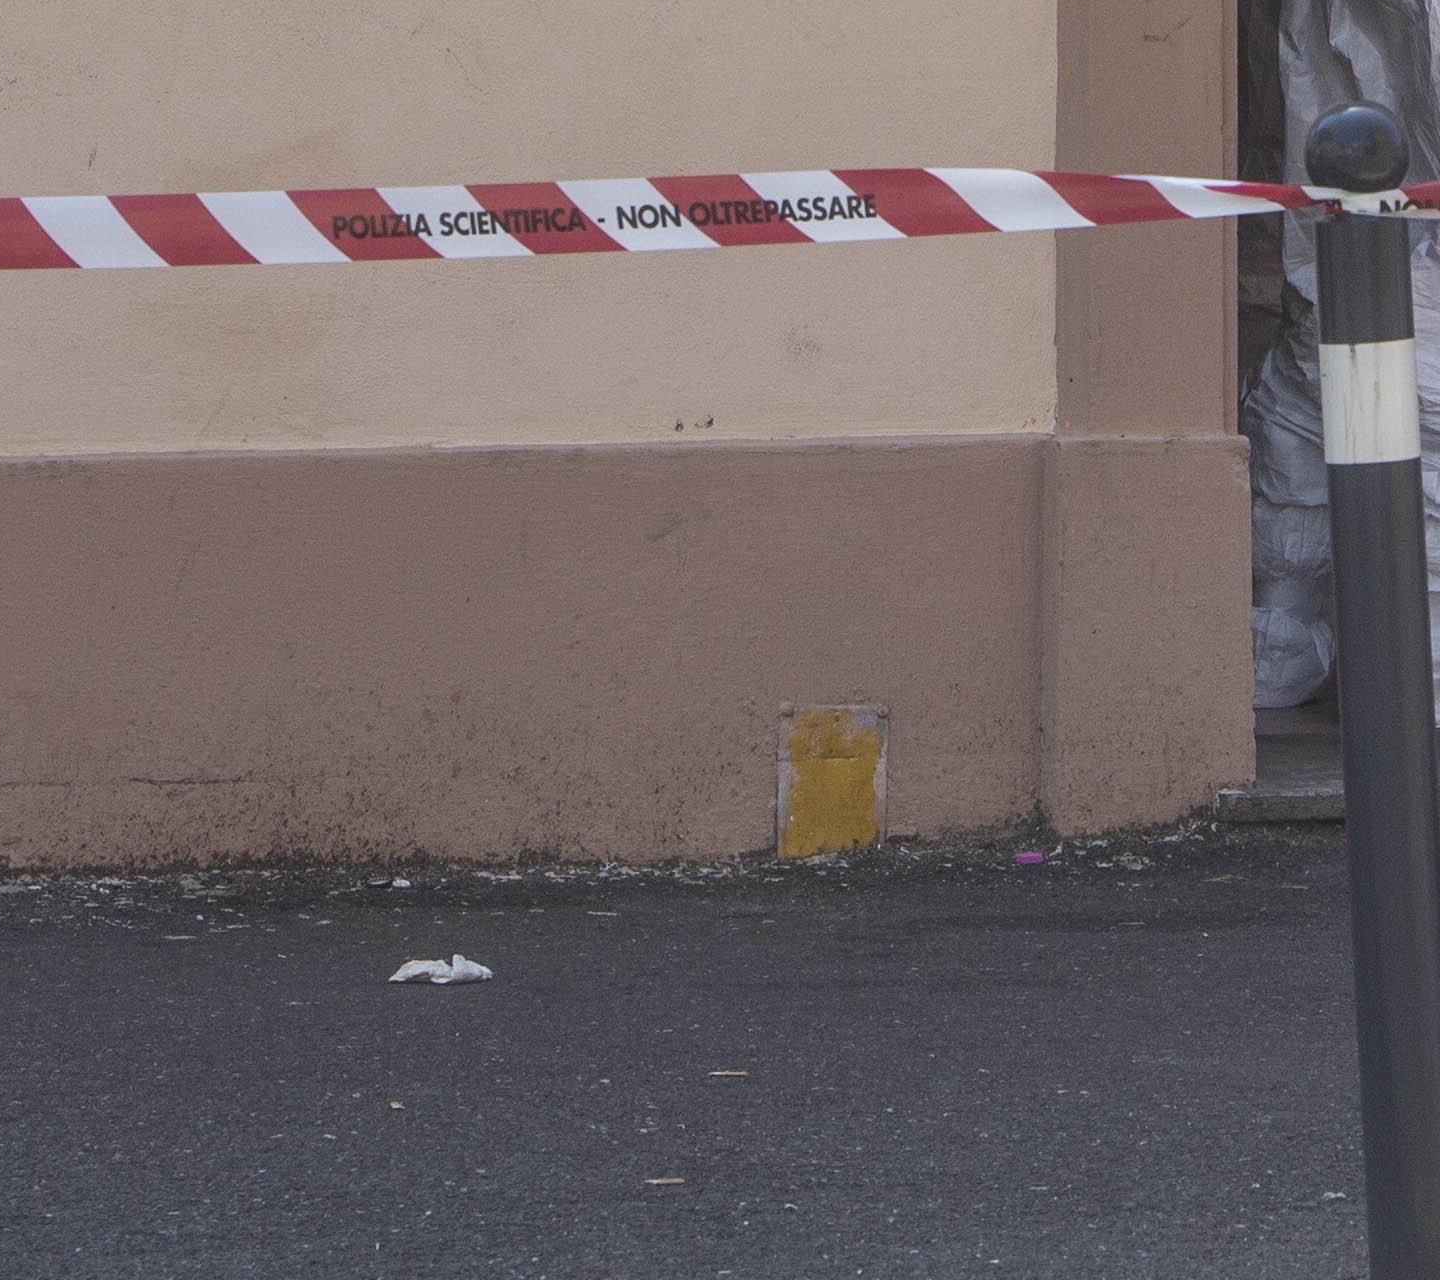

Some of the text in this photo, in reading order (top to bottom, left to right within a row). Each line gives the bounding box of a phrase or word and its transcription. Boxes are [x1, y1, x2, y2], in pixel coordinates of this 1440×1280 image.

[331, 211, 433, 242] POLIZIA
[438, 207, 588, 238] SCIENTIFICA
[615, 202, 682, 231] NON
[687, 193, 878, 227] OLTREPASSARE
